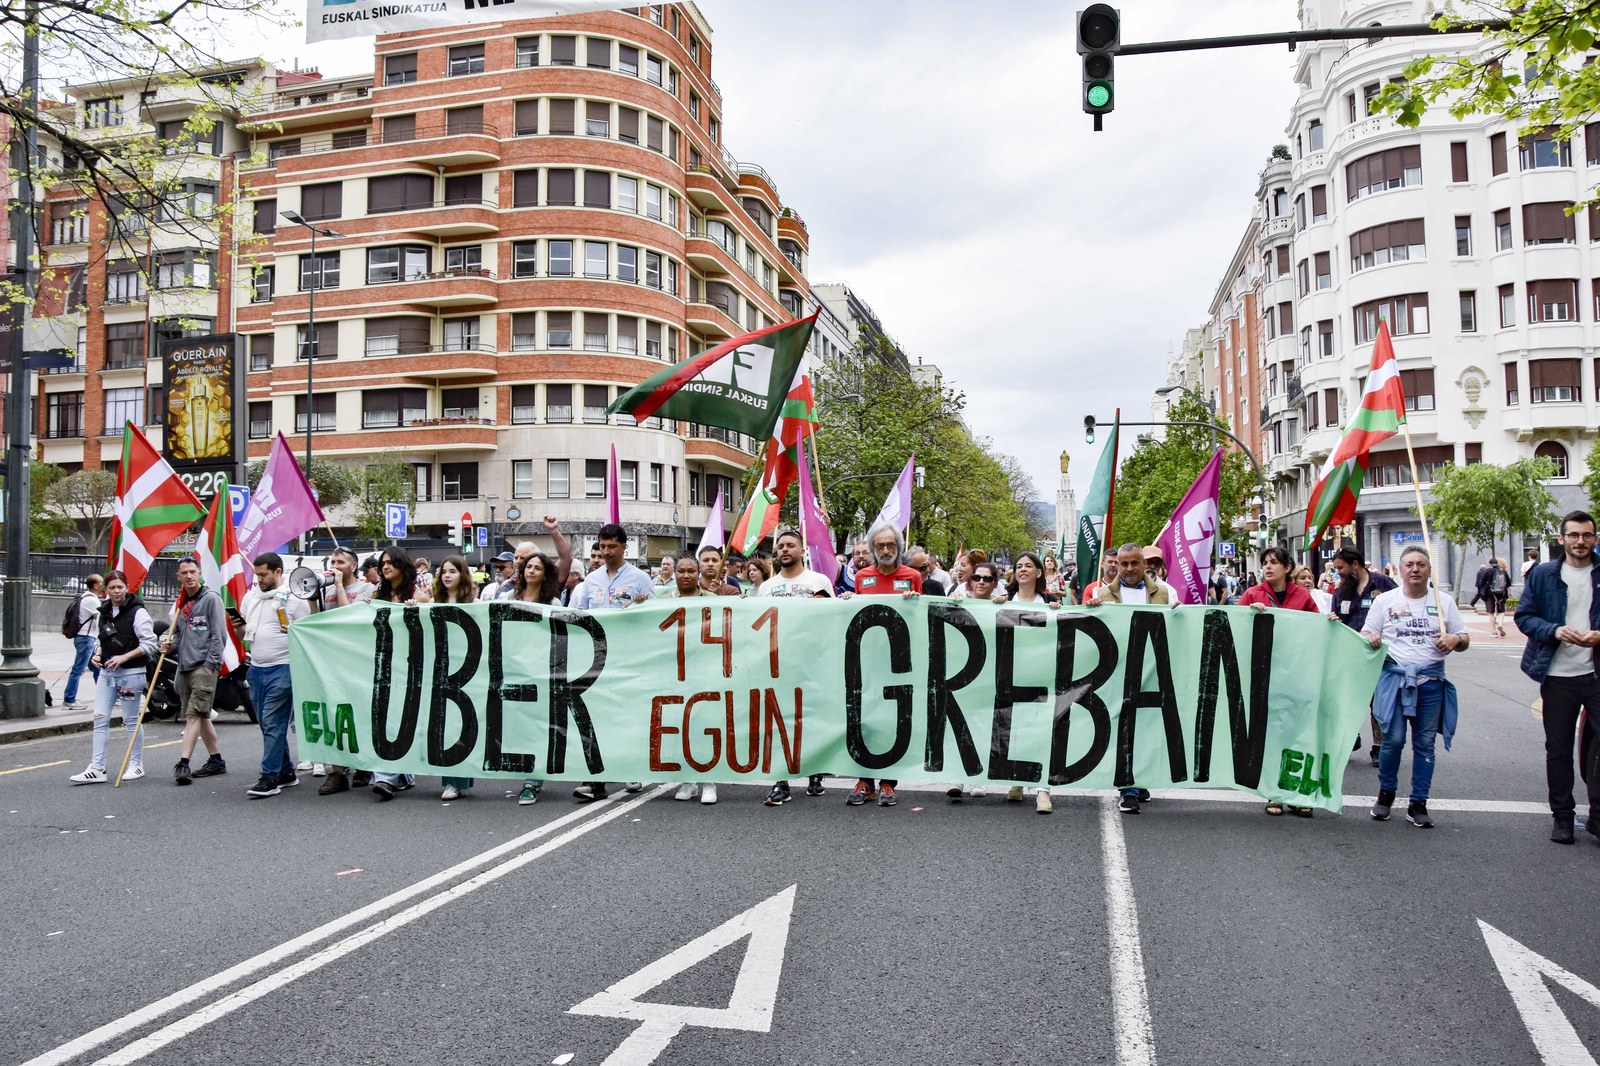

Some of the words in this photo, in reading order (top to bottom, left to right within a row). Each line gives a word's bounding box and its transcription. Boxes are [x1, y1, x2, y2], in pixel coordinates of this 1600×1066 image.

[322, 10, 370, 24] EUSKAL
[372, 2, 448, 18] SINDIKATUA
[173, 347, 227, 362] GUERLAIN
[389, 507, 402, 533] P
[1222, 543, 1233, 555] P
[863, 577, 875, 585] ELA
[894, 581, 909, 589] ELA
[1405, 618, 1431, 628] UBER
[658, 606, 780, 681] 141
[371, 603, 608, 775] UBER
[844, 603, 1275, 789] GREBAN
[302, 701, 360, 754] ELA
[649, 687, 803, 775] EGUN
